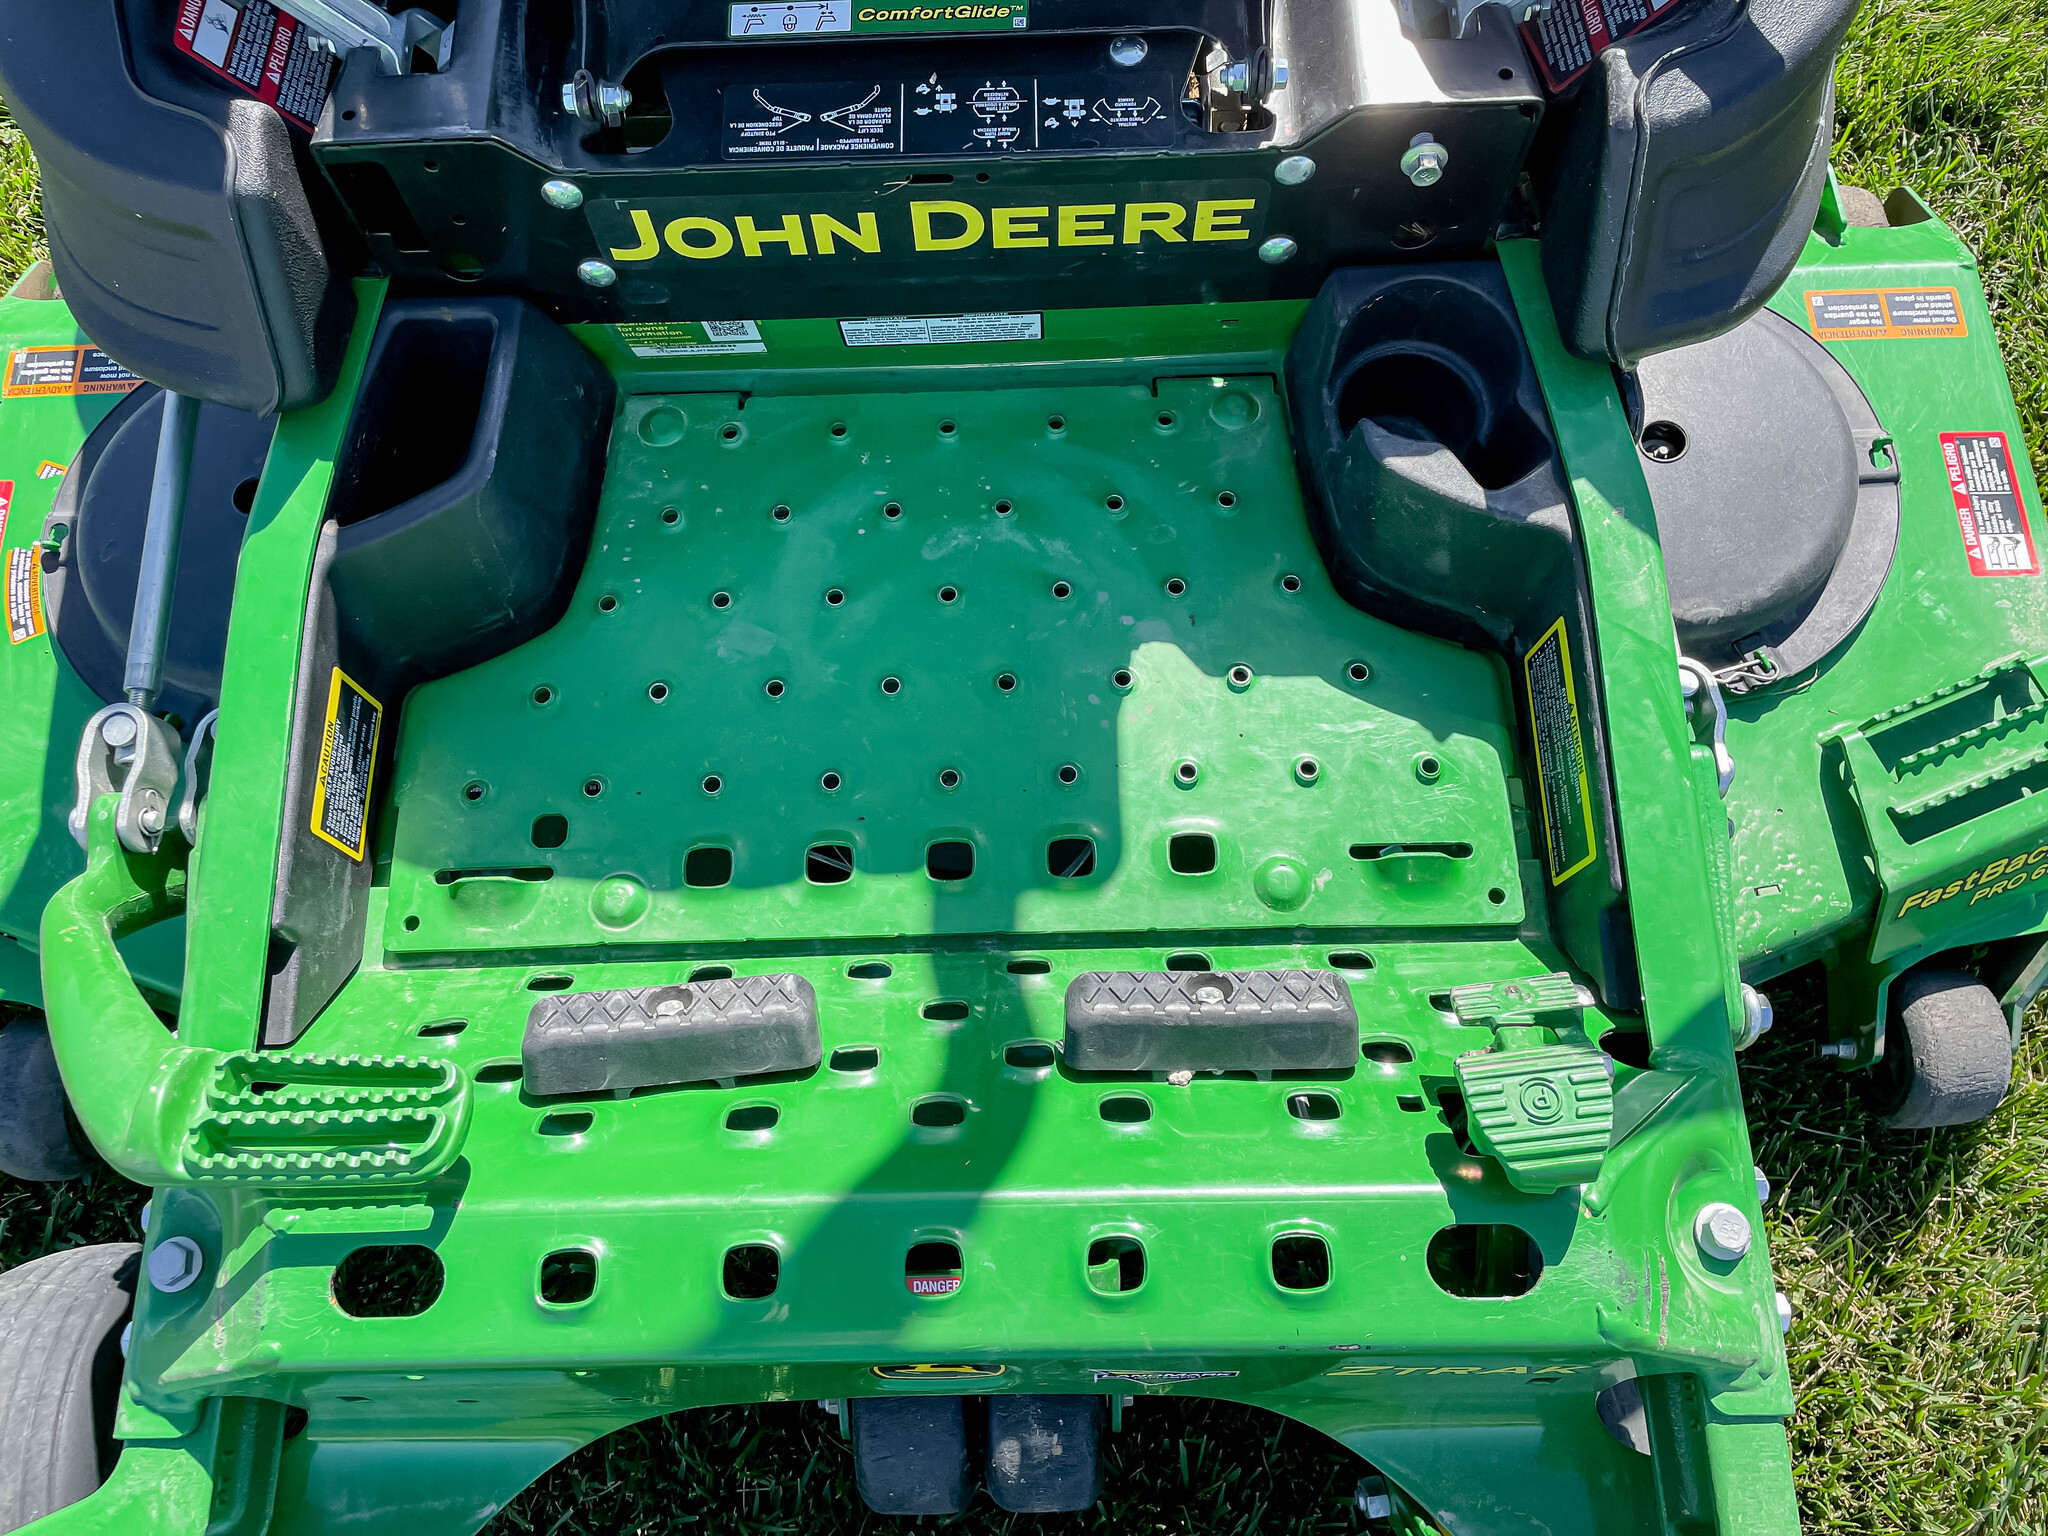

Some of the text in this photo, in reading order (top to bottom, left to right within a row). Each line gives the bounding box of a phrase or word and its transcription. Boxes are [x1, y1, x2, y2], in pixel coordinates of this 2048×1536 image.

[268, 24, 292, 74] PELIGRO
[609, 198, 1255, 260] JOHN DEERE
[1817, 329, 1877, 338] ADVERTENCIA
[1900, 327, 1943, 335] WARNING
[83, 383, 125, 391] WARNING
[1943, 442, 1962, 480] PELIGRO
[1959, 508, 1977, 545] DANGER
[320, 719, 334, 774] CAUTION
[328, 749, 336, 776] AVOID
[332, 717, 341, 749] INJURY
[1570, 713, 1584, 775] ATENCION
[1897, 844, 2048, 918] FastBac
[1969, 863, 2048, 905] PRO 6
[913, 1279, 960, 1293] DANGER
[1326, 1364, 1591, 1376] ZTRAK
